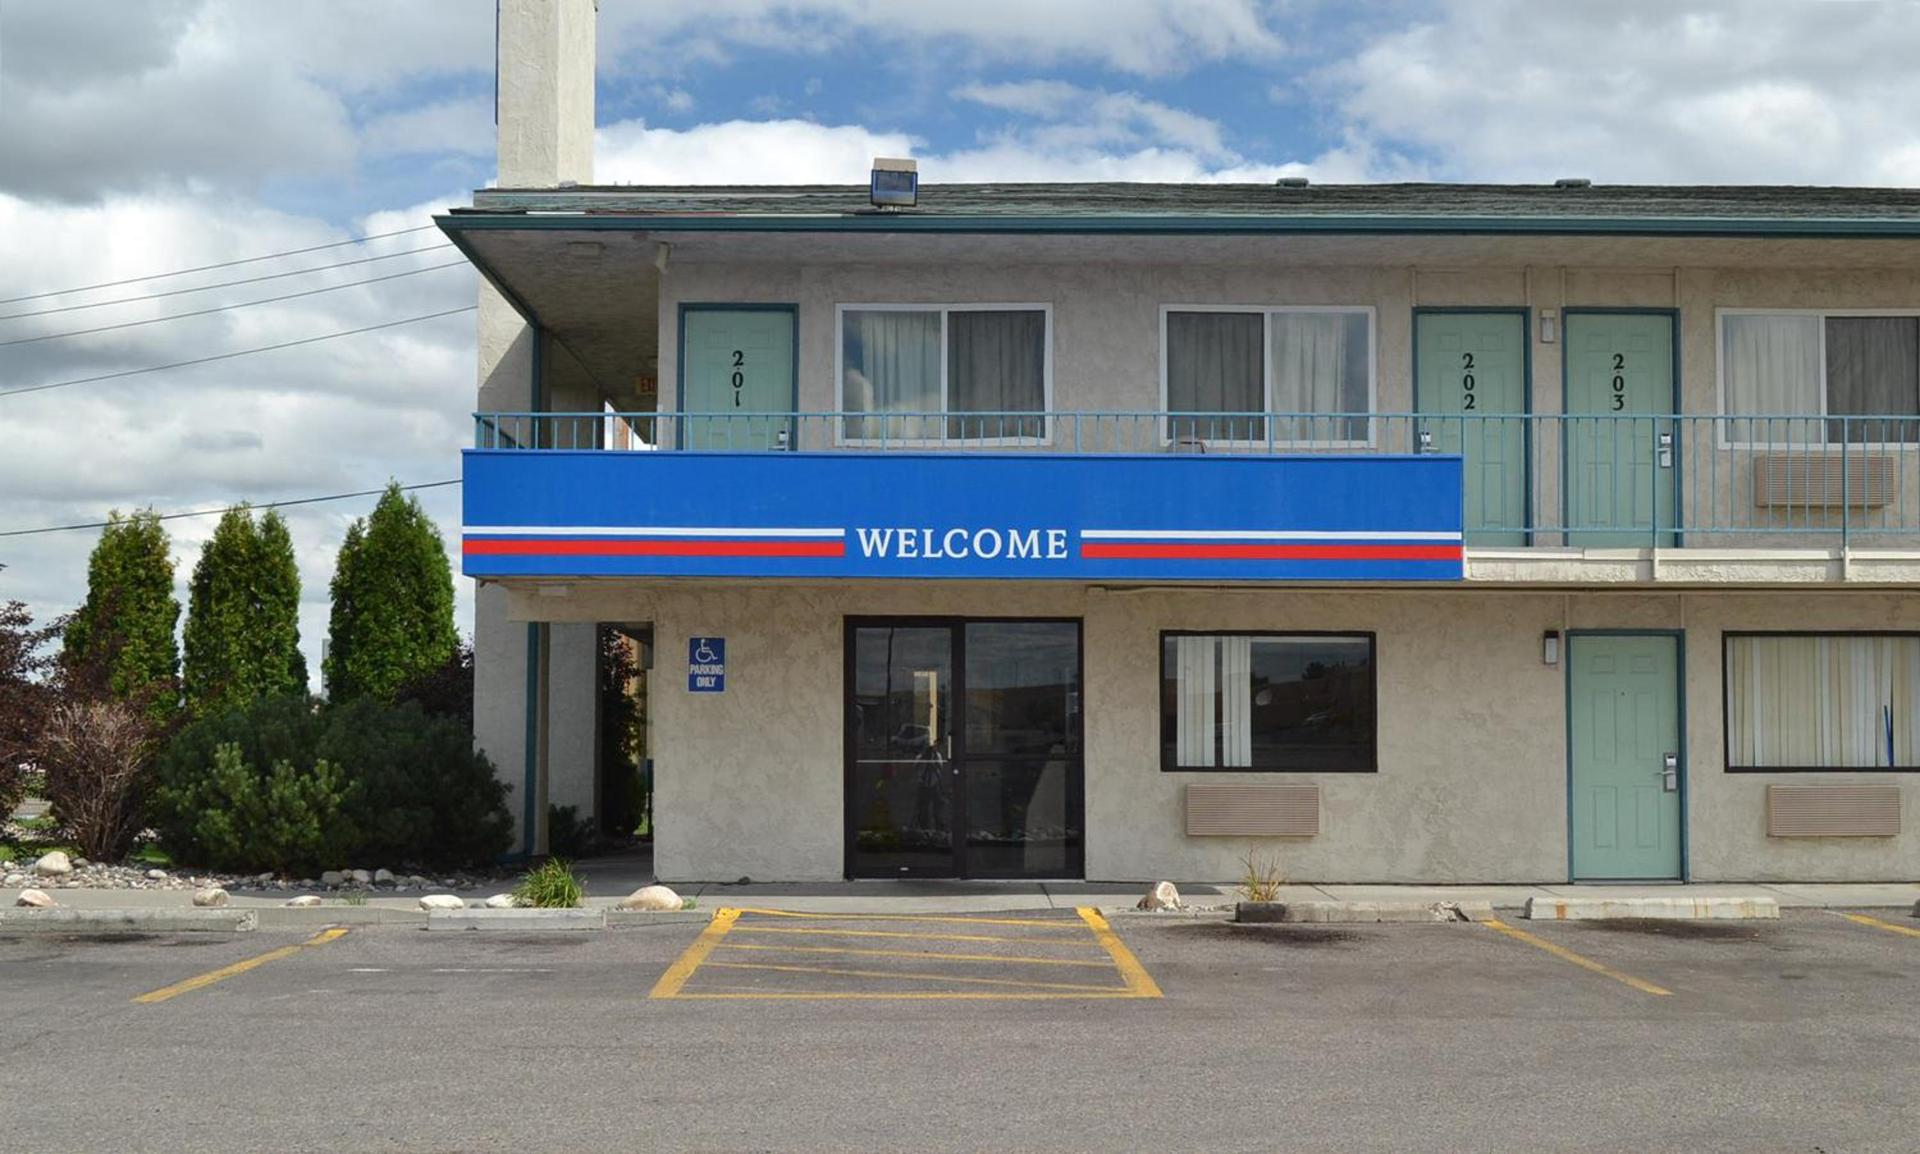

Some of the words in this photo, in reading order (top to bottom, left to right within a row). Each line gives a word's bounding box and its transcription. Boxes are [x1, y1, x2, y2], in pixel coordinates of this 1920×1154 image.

[732, 350, 744, 407] 201
[1462, 353, 1475, 410] 202
[1612, 353, 1625, 411] 203
[856, 528, 1068, 559] WELCOME
[690, 664, 724, 675] PARKING
[696, 676, 716, 688] ONLY
